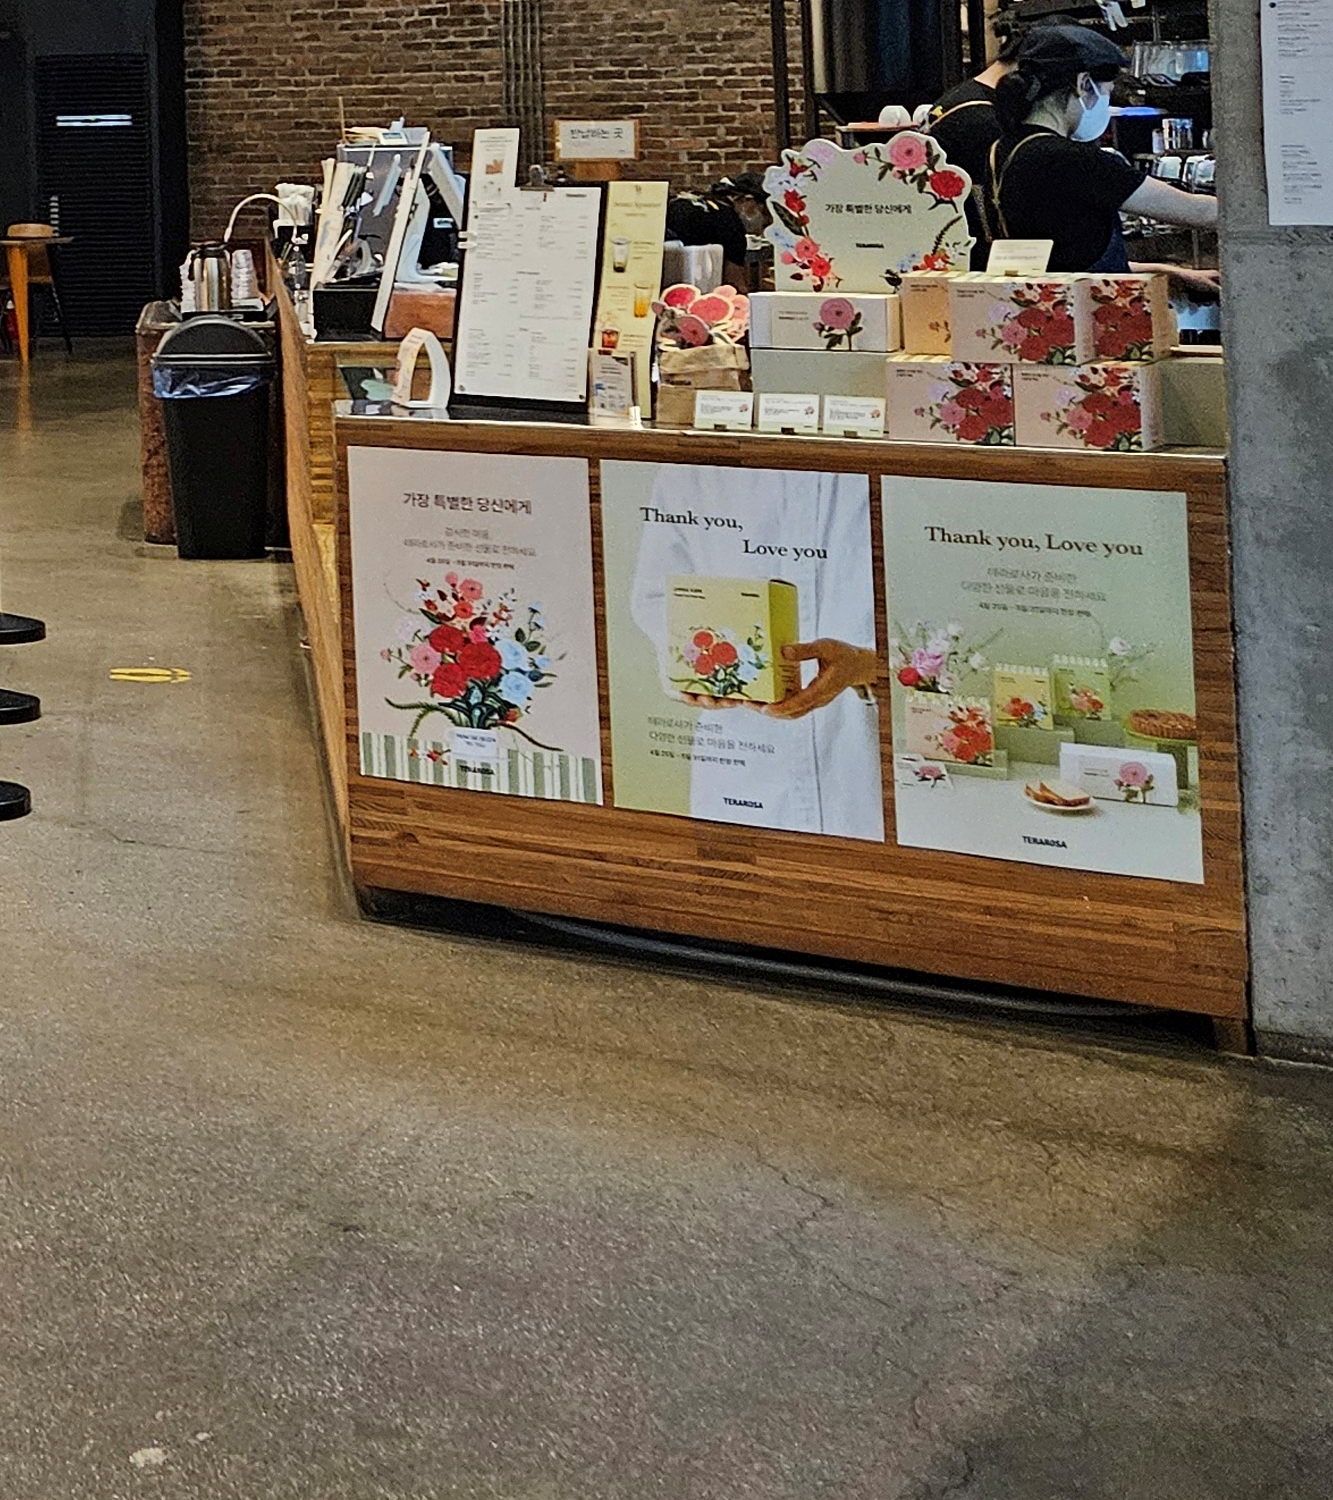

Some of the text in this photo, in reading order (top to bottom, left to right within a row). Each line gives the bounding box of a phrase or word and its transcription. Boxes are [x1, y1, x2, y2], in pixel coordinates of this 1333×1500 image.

[825, 203, 912, 214] 가장 특별한 당신에게
[403, 492, 533, 515] 가장 특별한 당신에게
[640, 507, 744, 531] Thank you,
[742, 539, 828, 561] Love you
[924, 526, 1144, 559] Thank you, Love you
[723, 796, 764, 809] TERAROSA
[1022, 835, 1068, 849] TERAROSA
